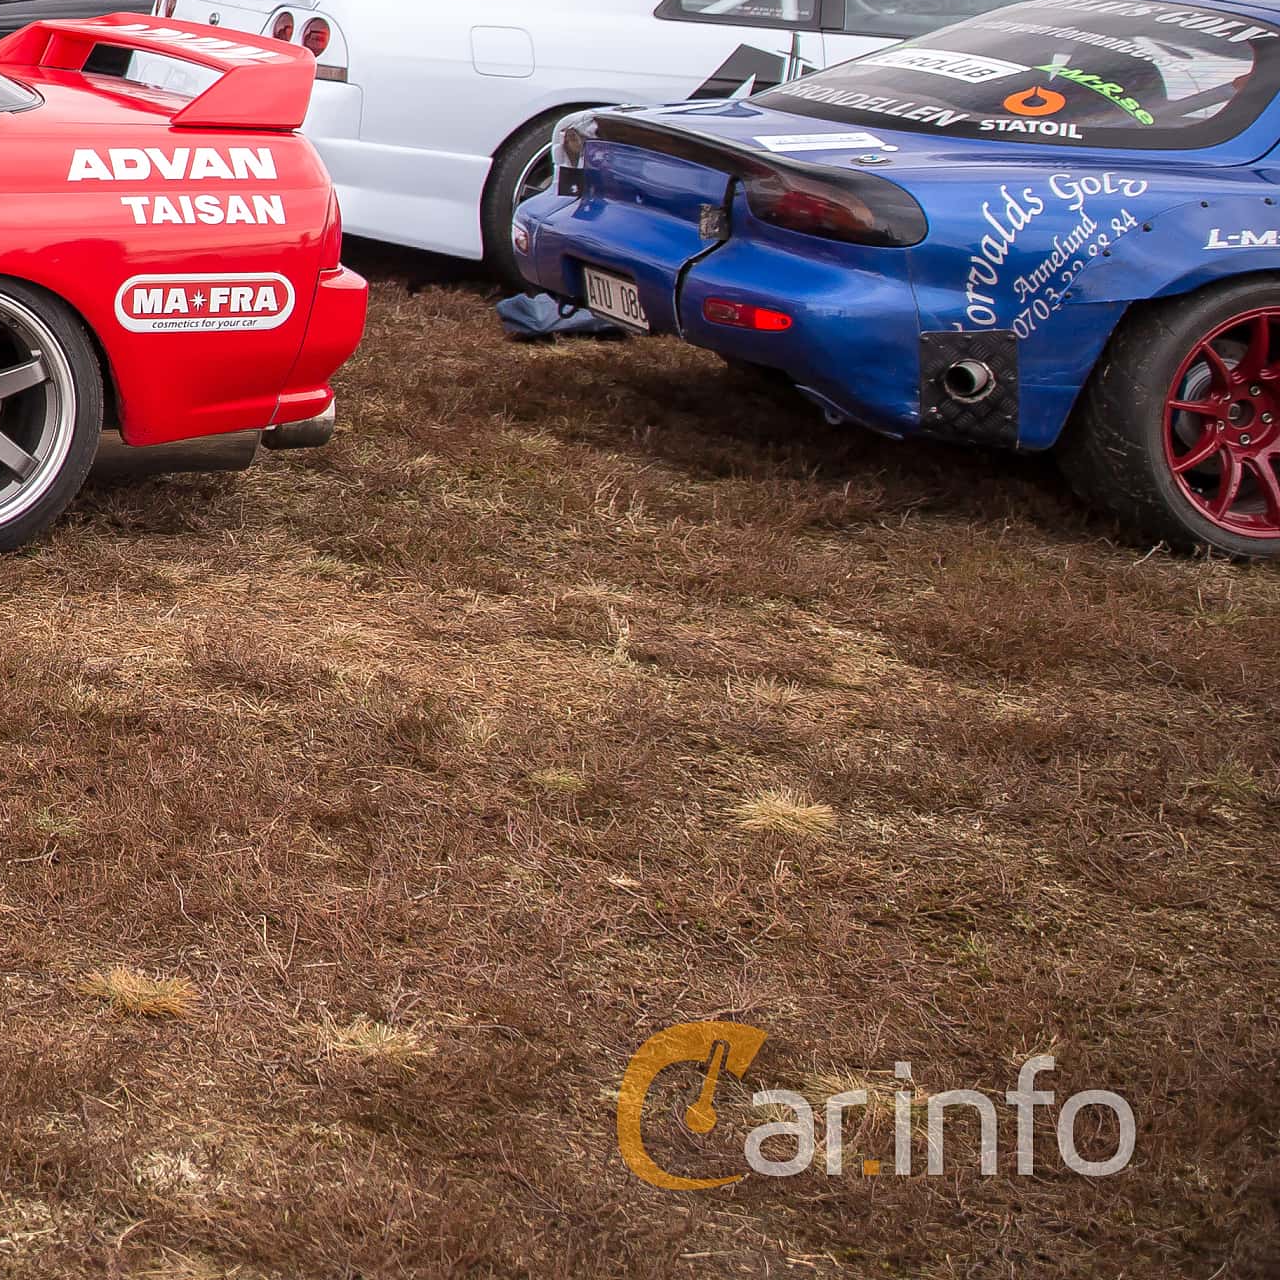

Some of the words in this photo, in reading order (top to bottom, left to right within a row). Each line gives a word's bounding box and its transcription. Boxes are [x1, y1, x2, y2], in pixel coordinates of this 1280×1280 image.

[979, 119, 1084, 140] STATOIL
[66, 147, 278, 182] ADVAN
[120, 194, 286, 225] TAISAN
[952, 184, 1044, 333] orvalds
[1014, 208, 1098, 304] Annelund
[589, 274, 613, 310] ATU
[152, 319, 199, 329] cosmetics
[201, 319, 216, 328] for
[216, 320, 240, 330] your
[242, 319, 258, 328] car
